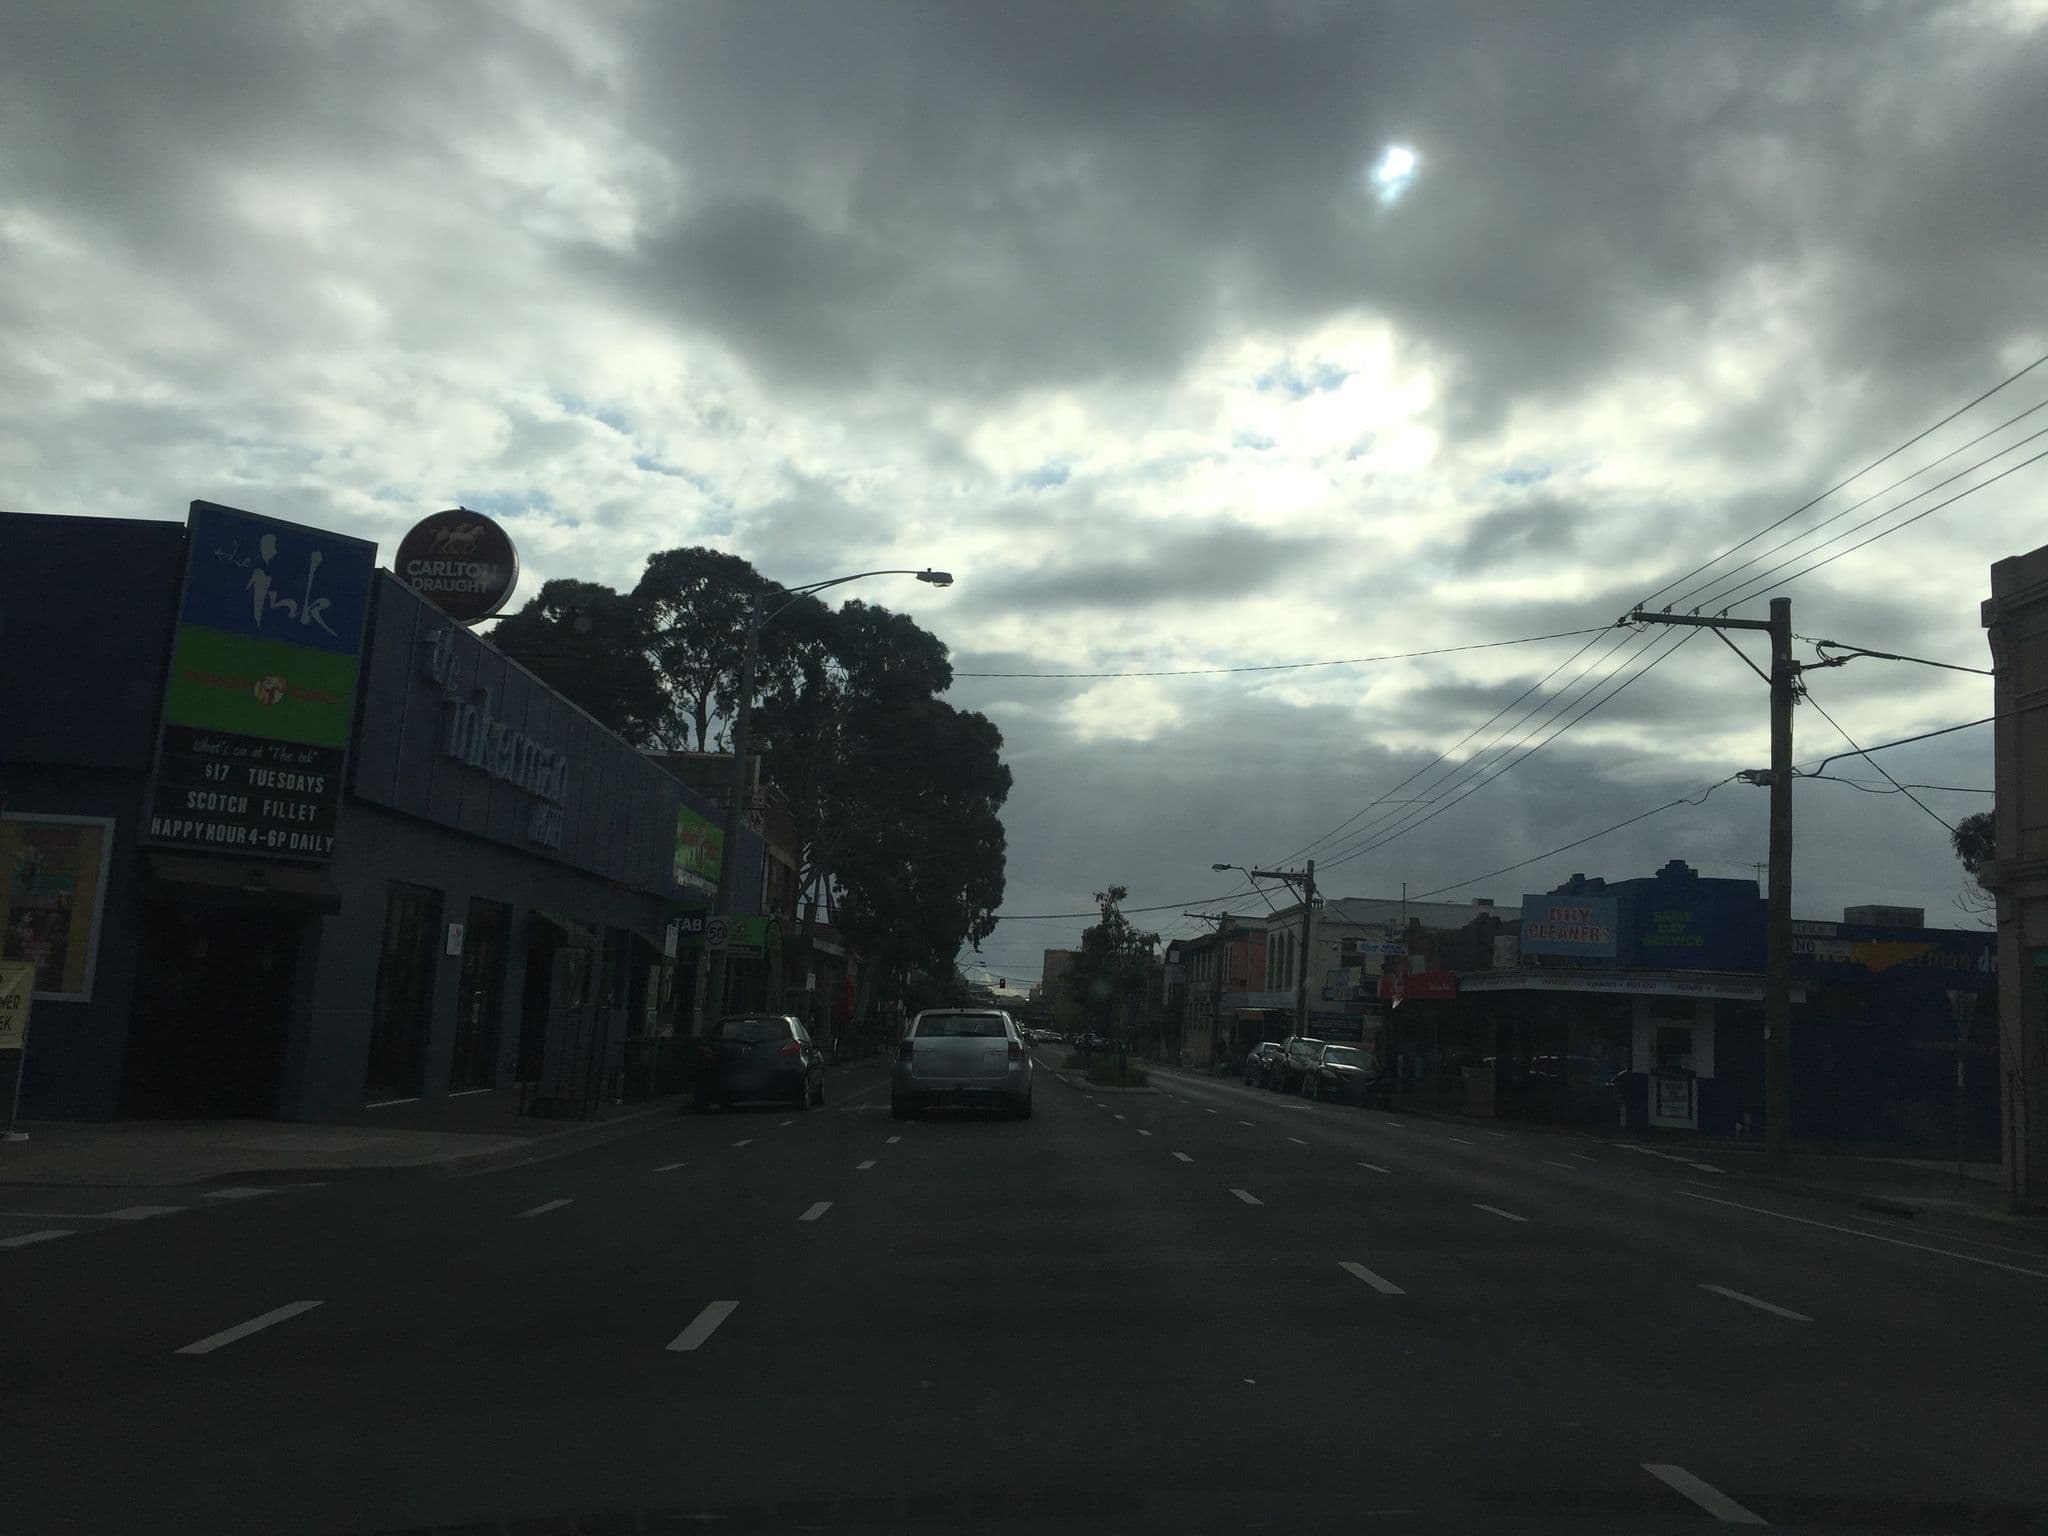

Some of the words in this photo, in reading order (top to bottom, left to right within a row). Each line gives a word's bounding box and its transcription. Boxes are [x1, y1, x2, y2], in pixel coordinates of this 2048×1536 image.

[407, 560, 497, 578] CARLTON
[246, 534, 338, 638] ink
[411, 578, 490, 592] DRAUGHT
[205, 763, 230, 781] $17
[249, 768, 323, 793] TUESDAYS
[187, 791, 248, 813] SCOTCH
[263, 800, 317, 822] FILLET
[151, 817, 205, 841] HAPPY
[205, 824, 247, 845] HOUR
[289, 832, 334, 854] DAILY
[1548, 905, 1592, 921] DRY
[672, 917, 703, 932] TAB
[709, 927, 724, 939] 50
[1527, 924, 1612, 944] CLEANERS
